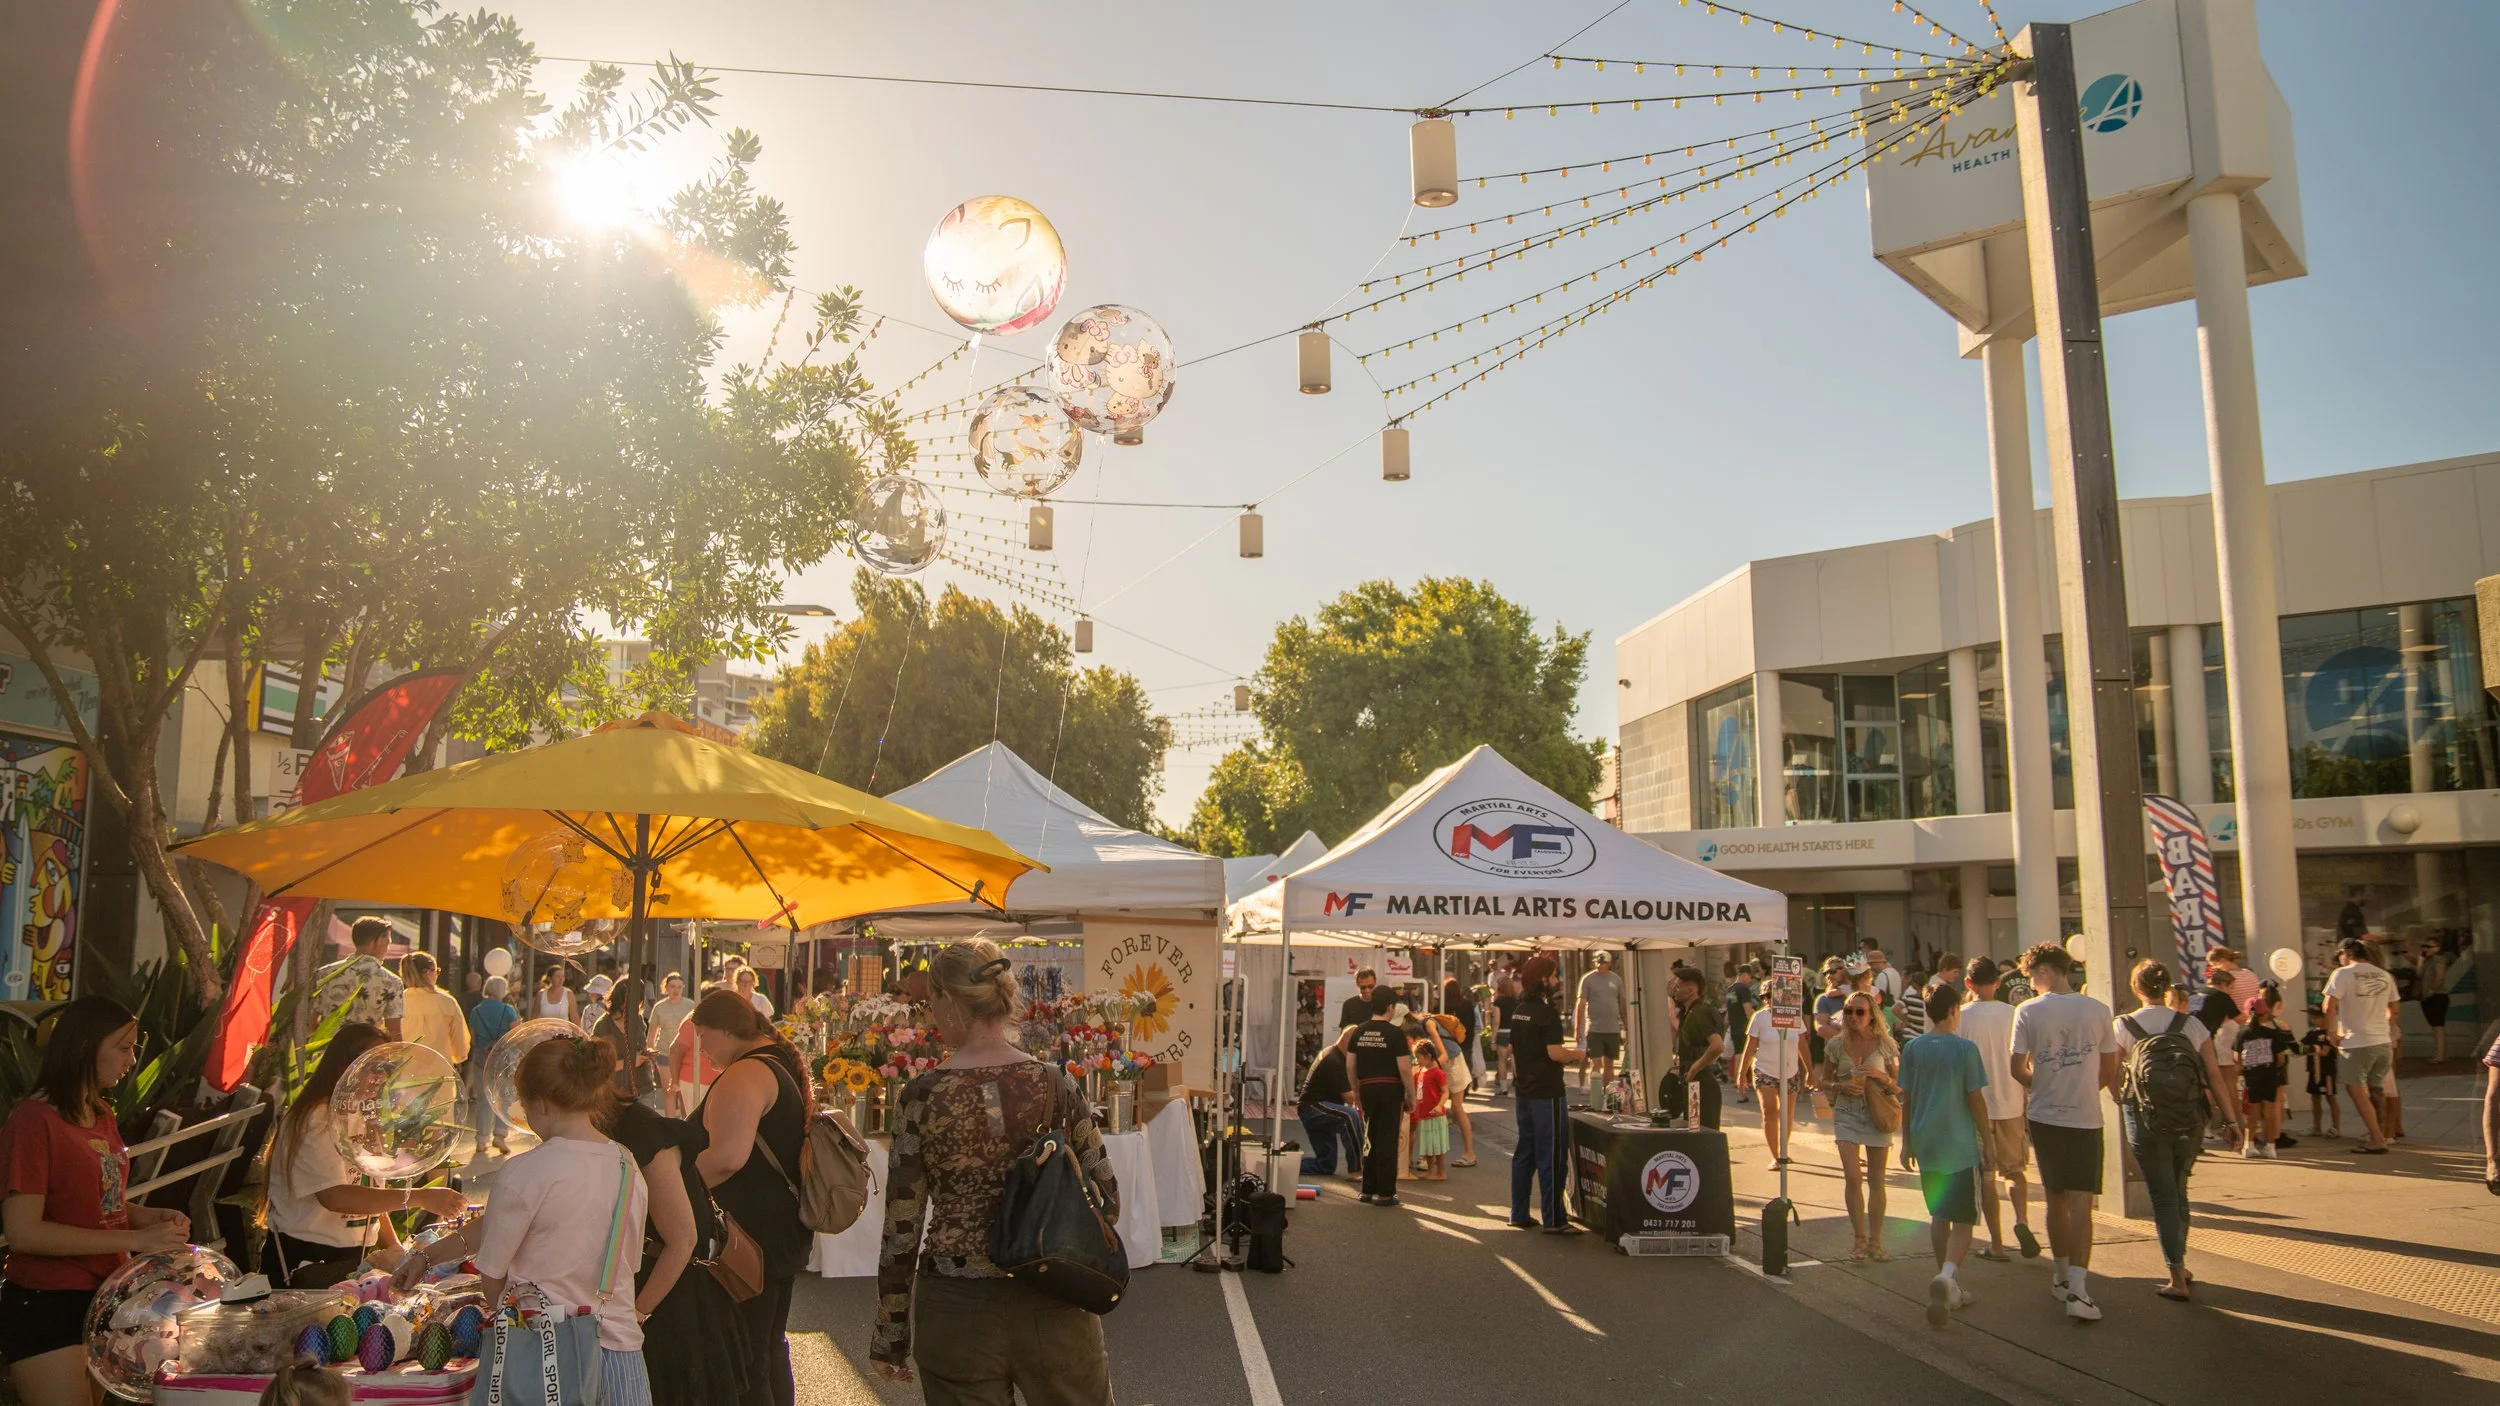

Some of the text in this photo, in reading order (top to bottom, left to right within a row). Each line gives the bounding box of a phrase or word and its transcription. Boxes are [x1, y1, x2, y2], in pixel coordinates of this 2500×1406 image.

[1953, 149, 2011, 173] HEALTH
[1460, 802, 1549, 819] MARTIAL ARTS
[2315, 815, 2355, 829] GYM
[1720, 839, 1876, 855] GOOD HEALTH STARTS HERE
[1490, 866, 1565, 876] FOR EVERYONE
[1386, 895, 1505, 916] MARTIAL
[1512, 896, 1577, 918] ARTS
[1585, 898, 1752, 922] CALOUNDRA
[1101, 934, 1193, 983] FOREVER
[1643, 1219, 1697, 1229] 0431 717 203
[545, 1364, 559, 1406] SPOR
